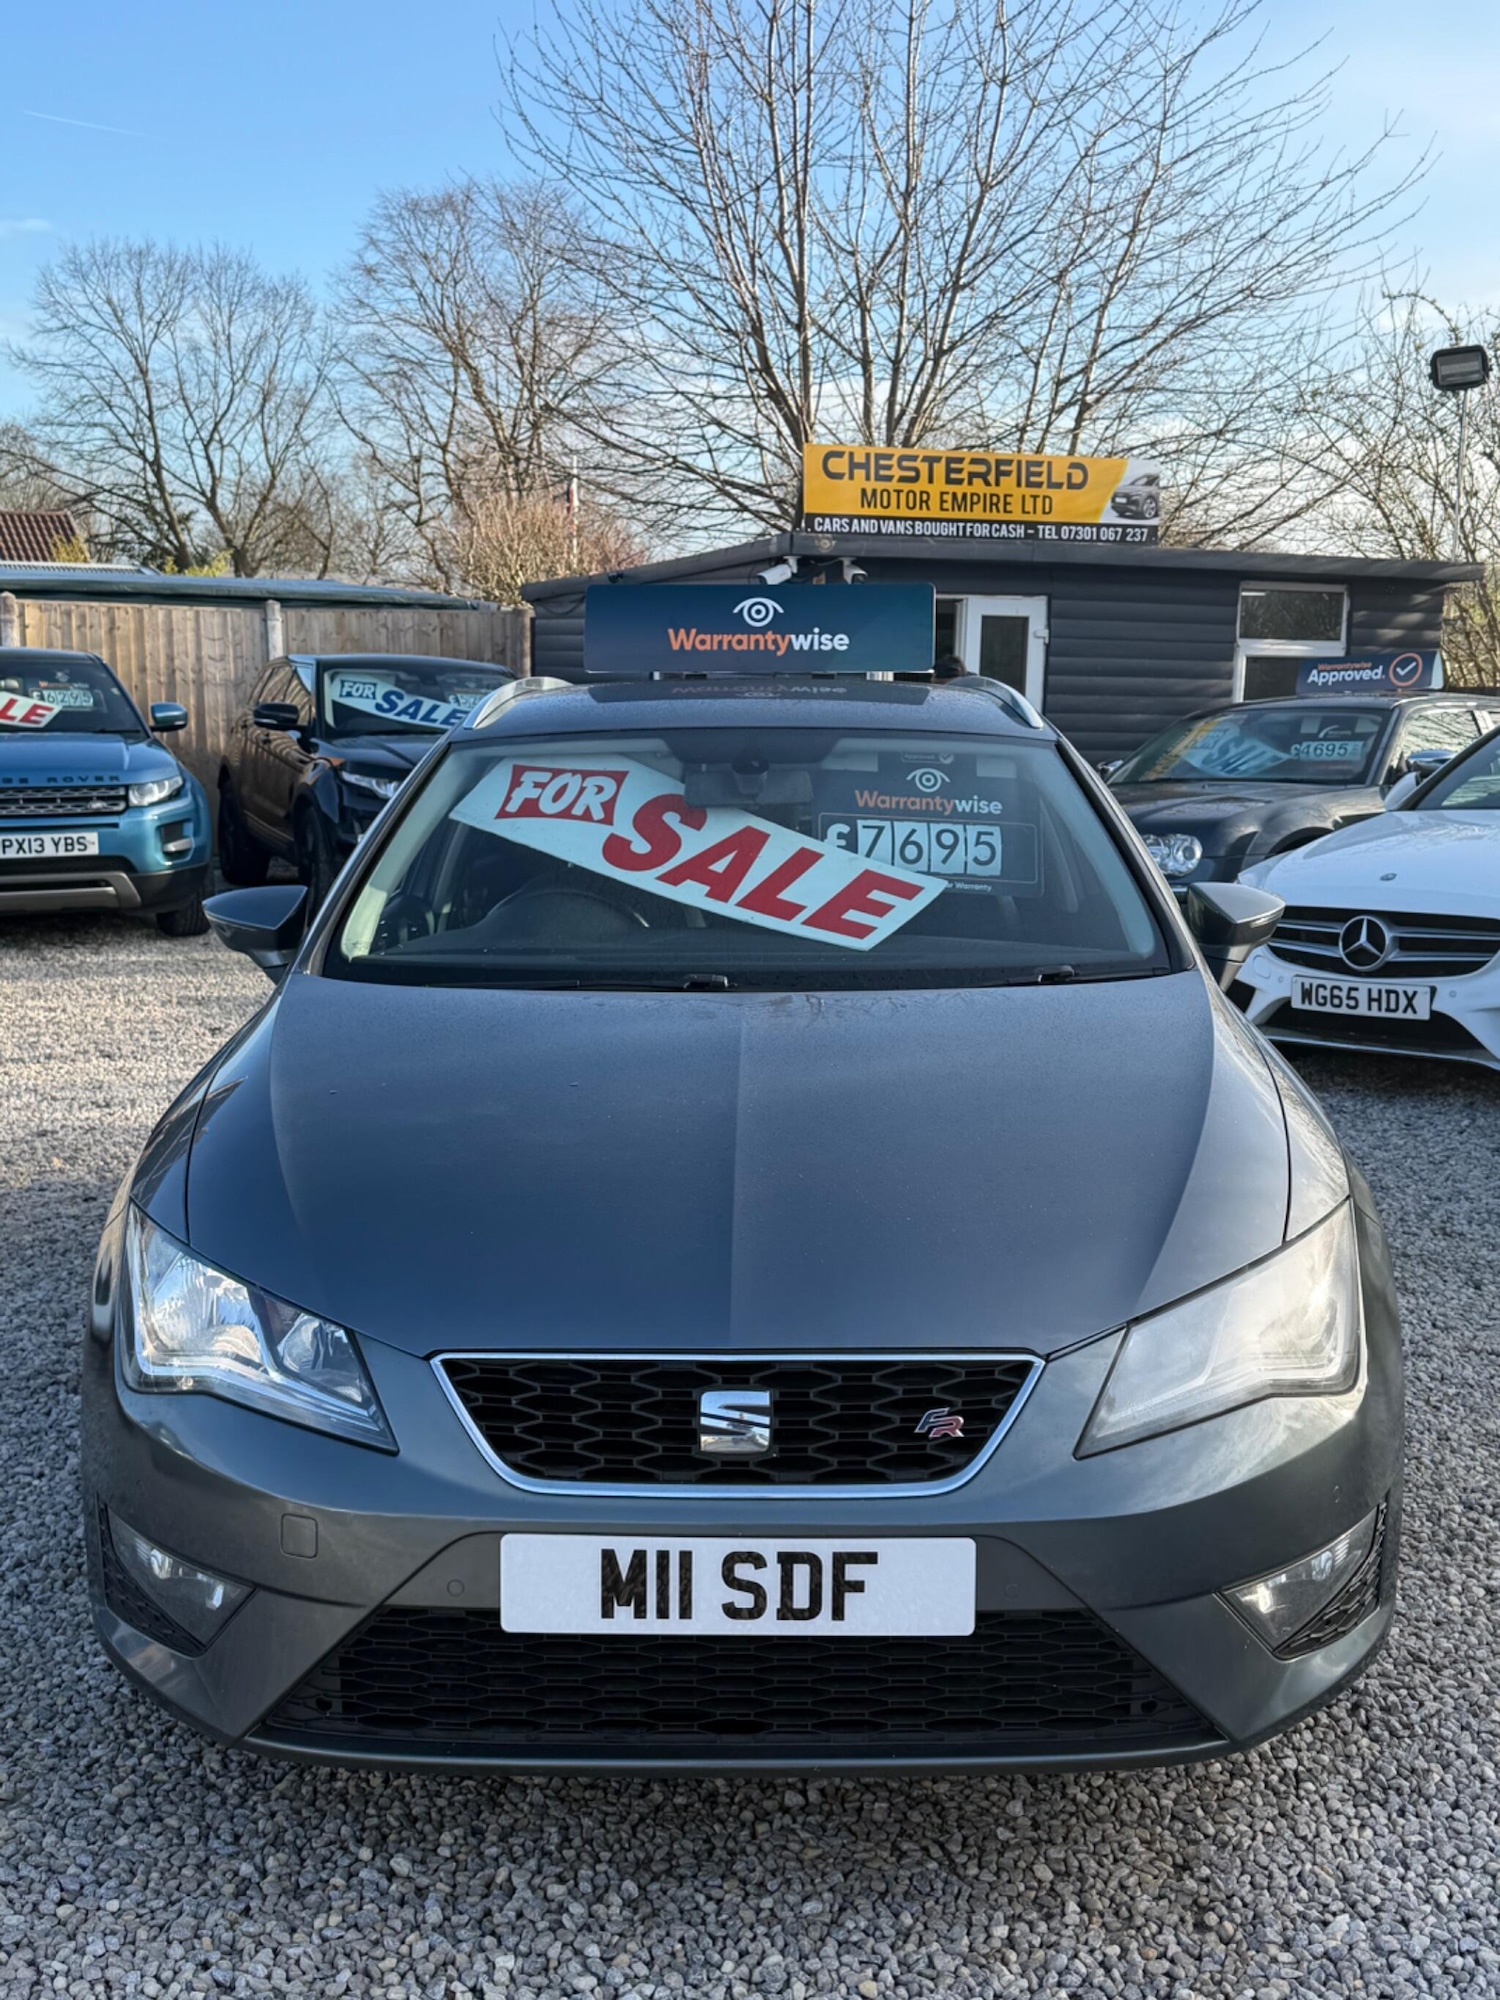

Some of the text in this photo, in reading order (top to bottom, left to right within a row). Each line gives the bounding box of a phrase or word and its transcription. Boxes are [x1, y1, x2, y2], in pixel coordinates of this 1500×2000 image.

[821, 449, 1089, 490] CHESTERFIELD
[860, 487, 1053, 515] MOTOR EMPIRE LTD
[814, 517, 850, 533] CARS
[851, 518, 878, 534] AND
[879, 519, 914, 535] VANS
[914, 520, 966, 536] BOUGHT
[967, 522, 991, 537] FOR
[991, 523, 1025, 538] CASH
[1037, 525, 1059, 539] TEL
[1061, 525, 1097, 540] 07301
[1100, 526, 1122, 541] 067
[1126, 528, 1148, 542] 237
[668, 627, 850, 657] Warrantywise
[0, 697, 55, 725] LE
[341, 682, 376, 699] FOR
[375, 690, 470, 726] SALE
[855, 790, 1003, 816] Warrantywise
[2, 836, 88, 855] PX13 YBS
[504, 771, 925, 940] FOR SALE
[824, 822, 997, 867] £7695
[1301, 982, 1418, 1015] WG65 HDX
[600, 1548, 879, 1622] M11 SDF
